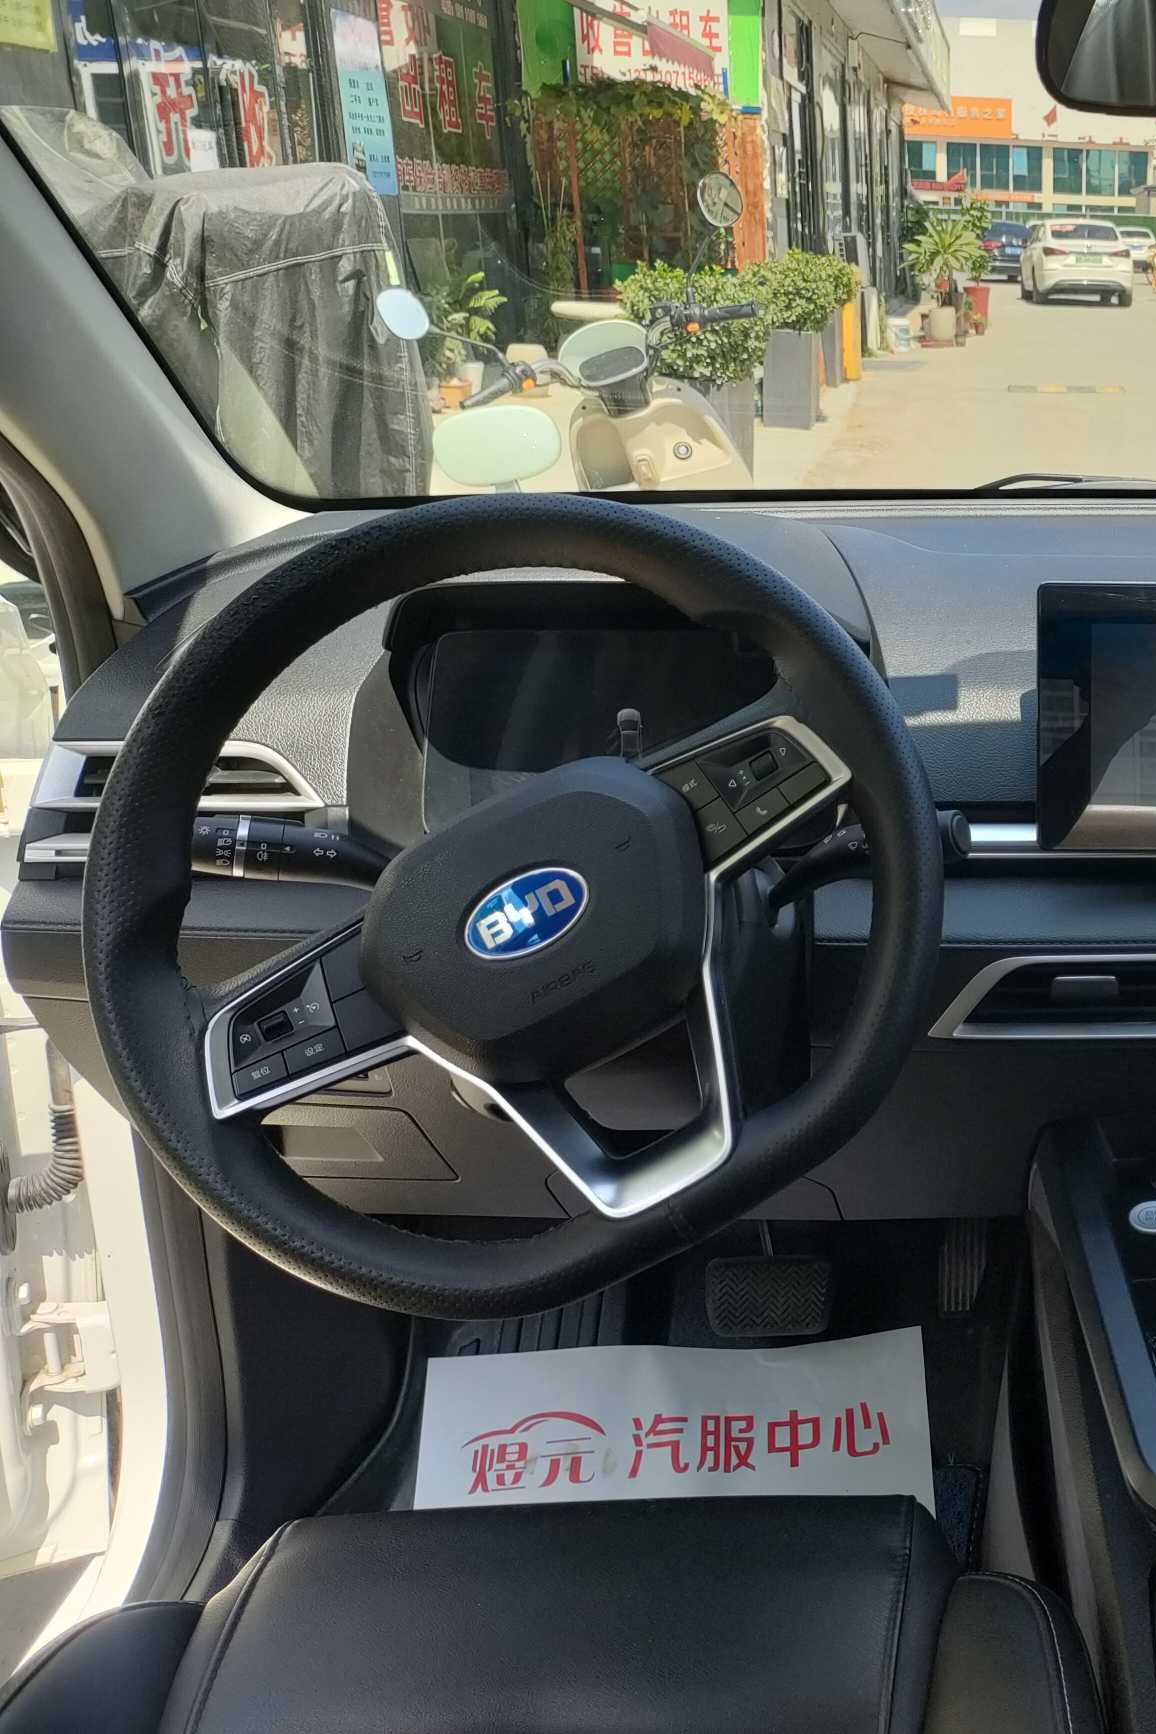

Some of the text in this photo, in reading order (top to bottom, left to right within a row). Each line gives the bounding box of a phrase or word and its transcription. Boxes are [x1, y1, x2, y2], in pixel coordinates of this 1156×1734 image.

[475, 878, 577, 950] BYD
[467, 1401, 892, 1496] 煜元 汽服中心
